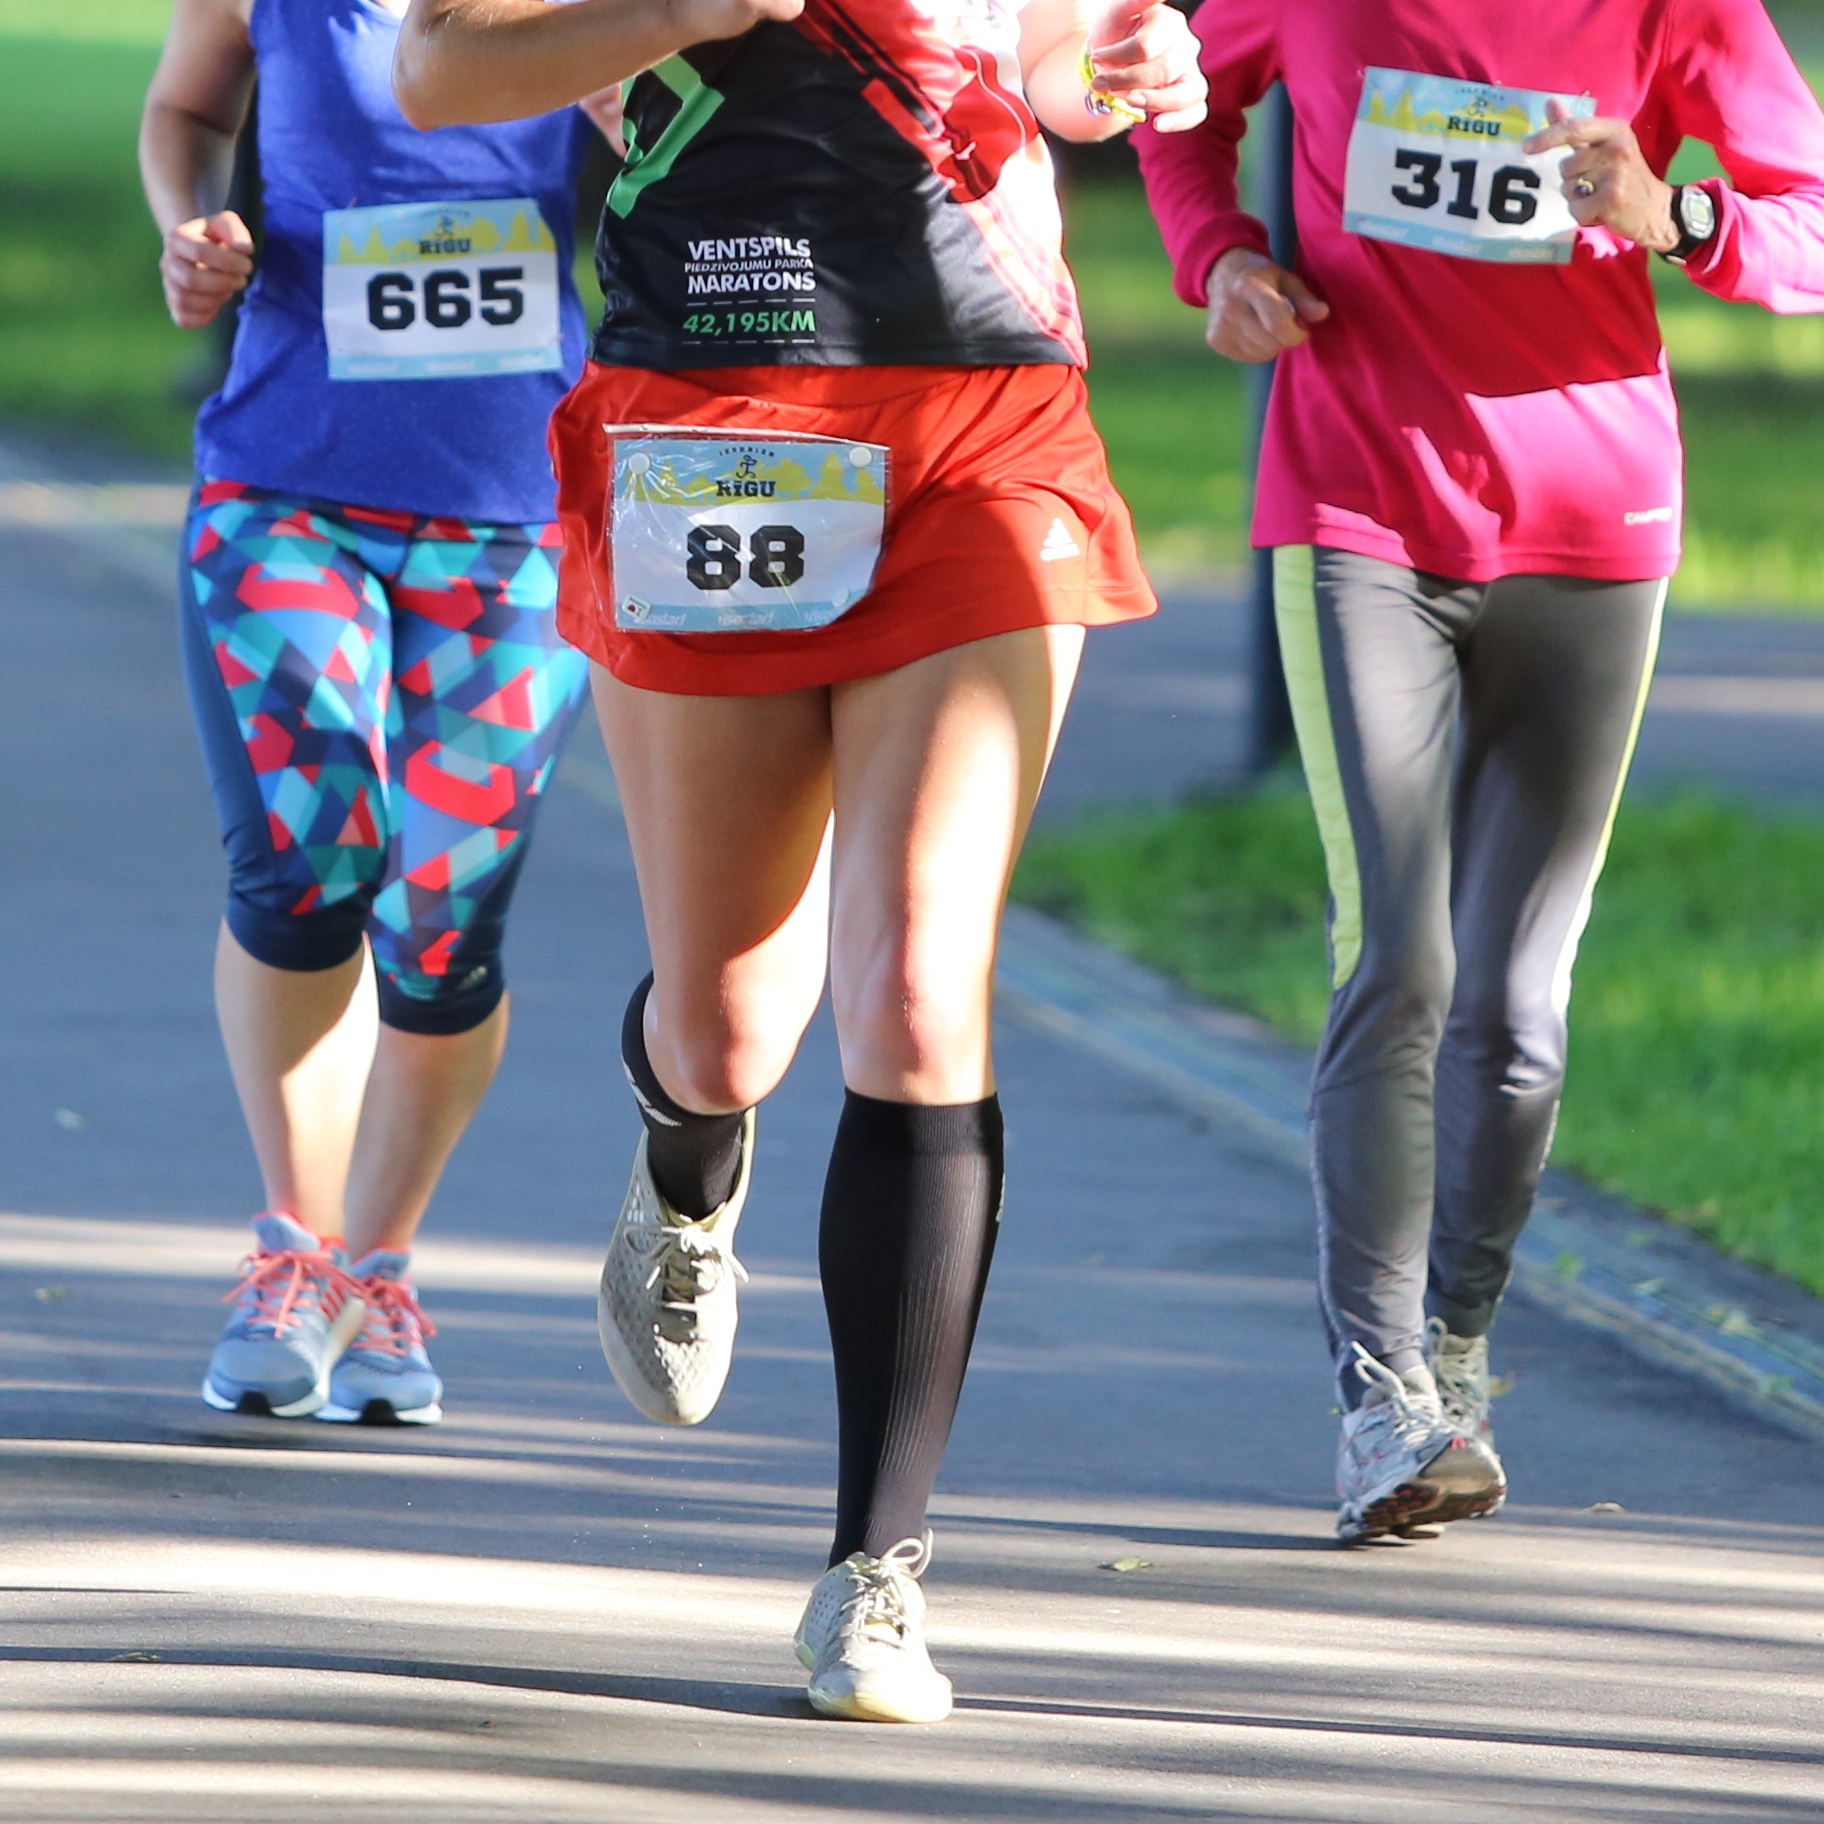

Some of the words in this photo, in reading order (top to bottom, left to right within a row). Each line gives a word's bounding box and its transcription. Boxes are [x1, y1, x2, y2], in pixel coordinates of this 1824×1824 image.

[1391, 148, 1541, 226] 316
[687, 236, 812, 261] VENTSPILS
[774, 258, 814, 270] PARKA
[687, 271, 817, 295] MARATONS
[367, 266, 524, 331] 665
[682, 310, 817, 337] 42,195KM
[687, 525, 804, 590] 88
